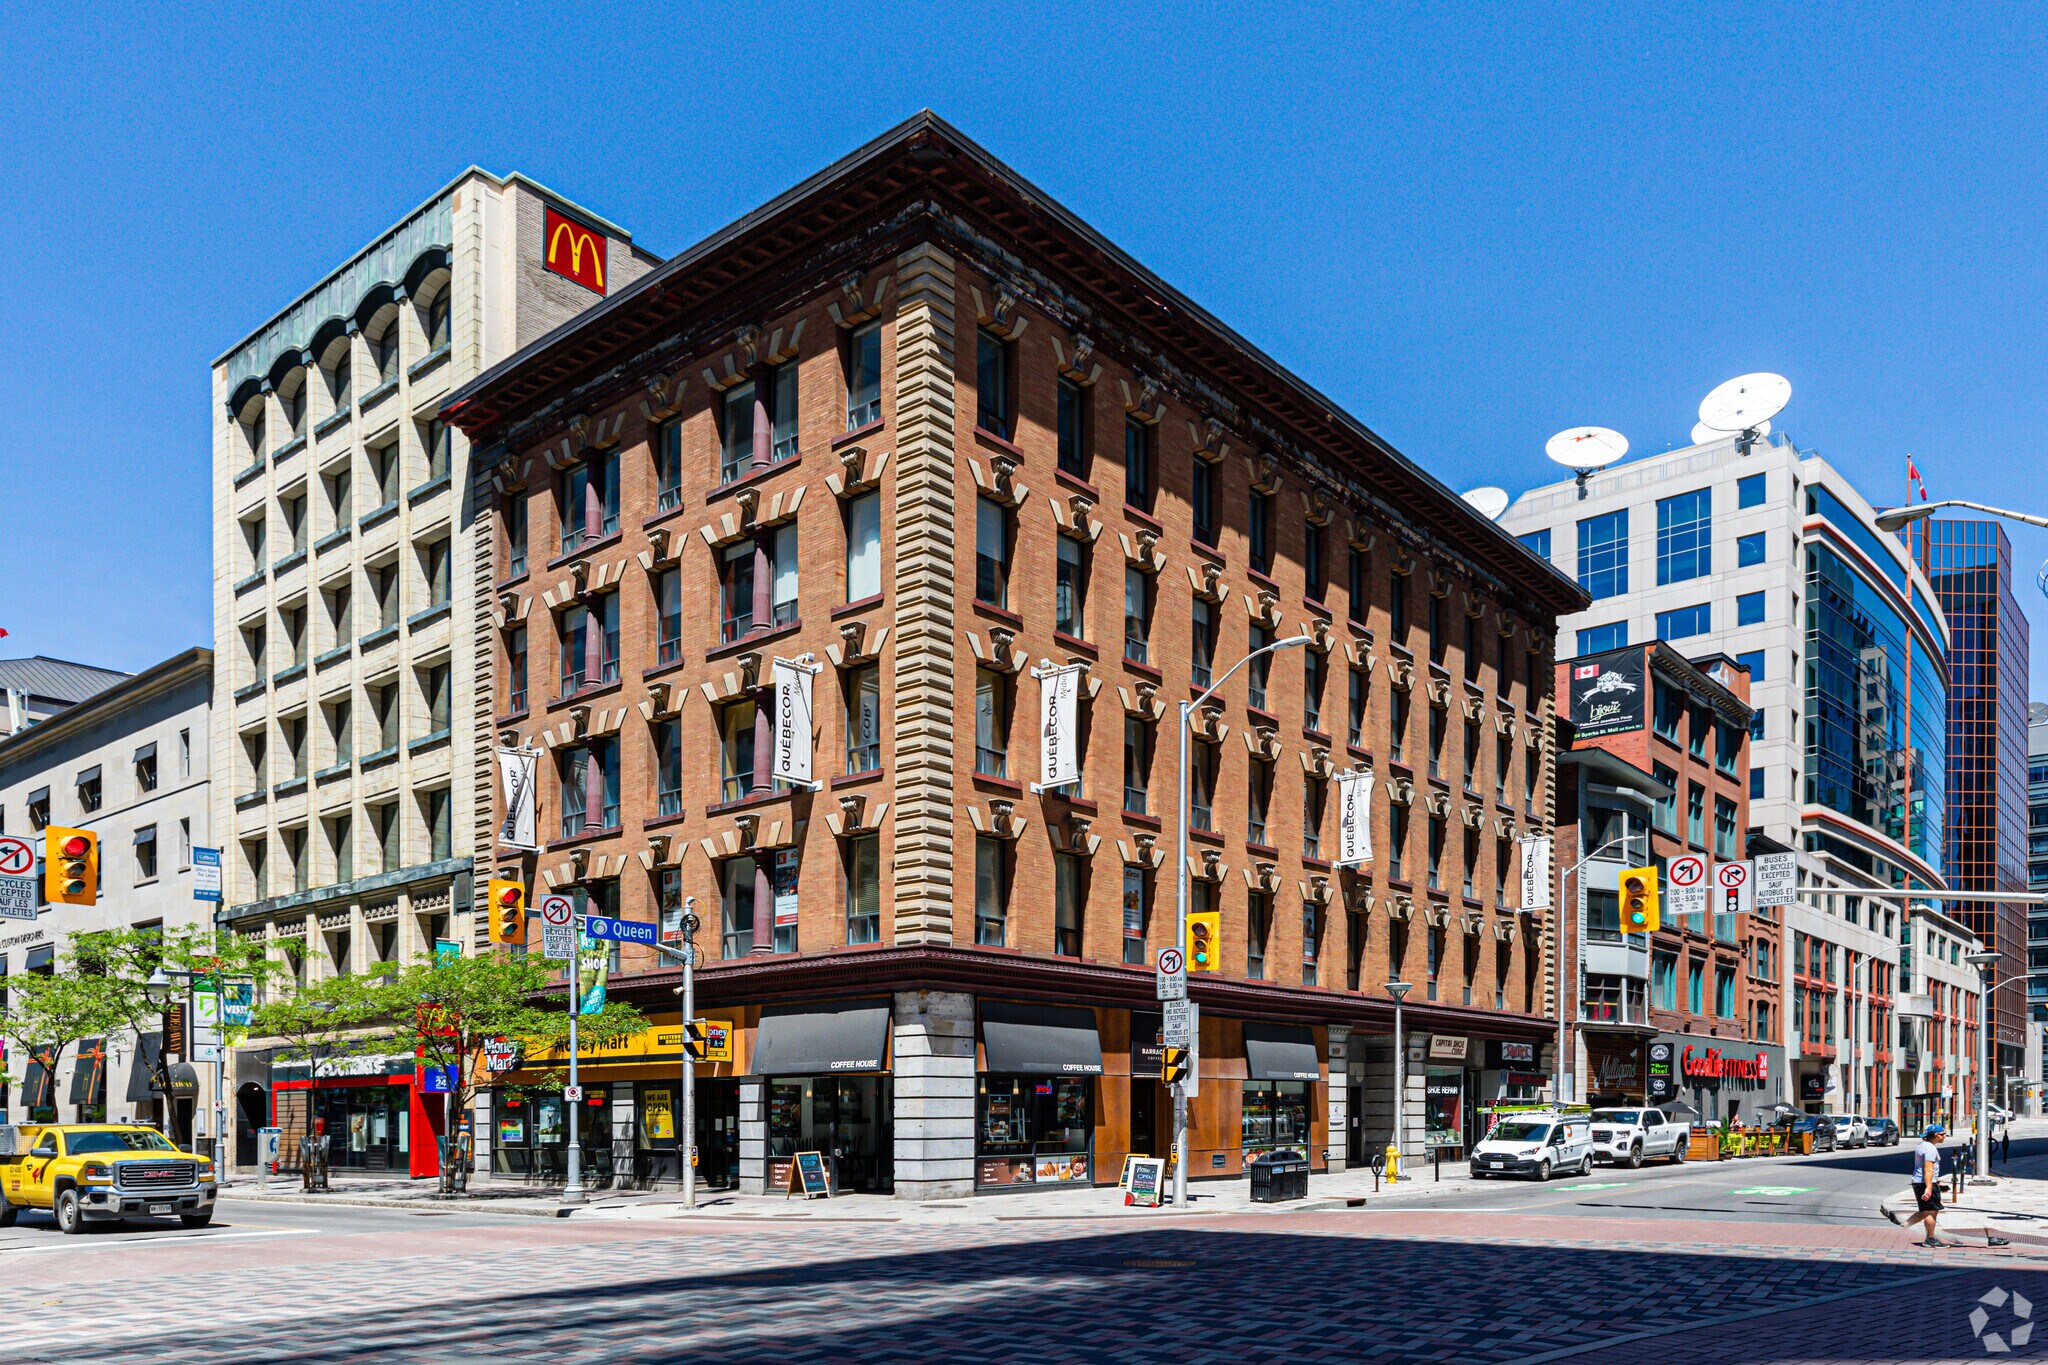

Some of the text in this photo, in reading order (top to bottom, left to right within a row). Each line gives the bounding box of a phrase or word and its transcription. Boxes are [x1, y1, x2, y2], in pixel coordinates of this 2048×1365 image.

[780, 686, 791, 772] QUÉBECOR
[1047, 695, 1058, 779] QUÉBECOR
[1345, 794, 1355, 858] QUÉBECOR
[1764, 855, 1788, 863] BUSES
[1770, 862, 1794, 870] BICYCLES
[1526, 854, 1534, 906] QUÉBECOR
[1761, 870, 1790, 880] EXCEPTED
[1768, 881, 1783, 889] SAUF
[1670, 888, 1680, 896] 7:00
[1758, 889, 1785, 898] AUTOBUS
[15, 899, 28, 908] LES
[1757, 895, 1794, 905] BICYCLETTES
[545, 928, 572, 936] BICYCLES
[613, 921, 652, 940] Queen
[546, 949, 574, 958] BICYCLETTES
[582, 957, 607, 970] SHOP
[708, 1028, 728, 1039] oney
[484, 1038, 517, 1055] Money
[600, 1034, 628, 1051] Mart
[1435, 1038, 1465, 1048] CAPITAL SHOE
[486, 1053, 514, 1071] Mart
[831, 1059, 878, 1068] COFFEE HOUSE
[1682, 1044, 1767, 1080] GoodLife FITNESS 24
[1062, 1063, 1102, 1072] COFFEE HOUSE
[435, 1079, 447, 1087] 24
[1427, 1085, 1458, 1094] SHOE REPAIR
[647, 1102, 669, 1112] OPEN
[144, 1170, 175, 1179] GMC
